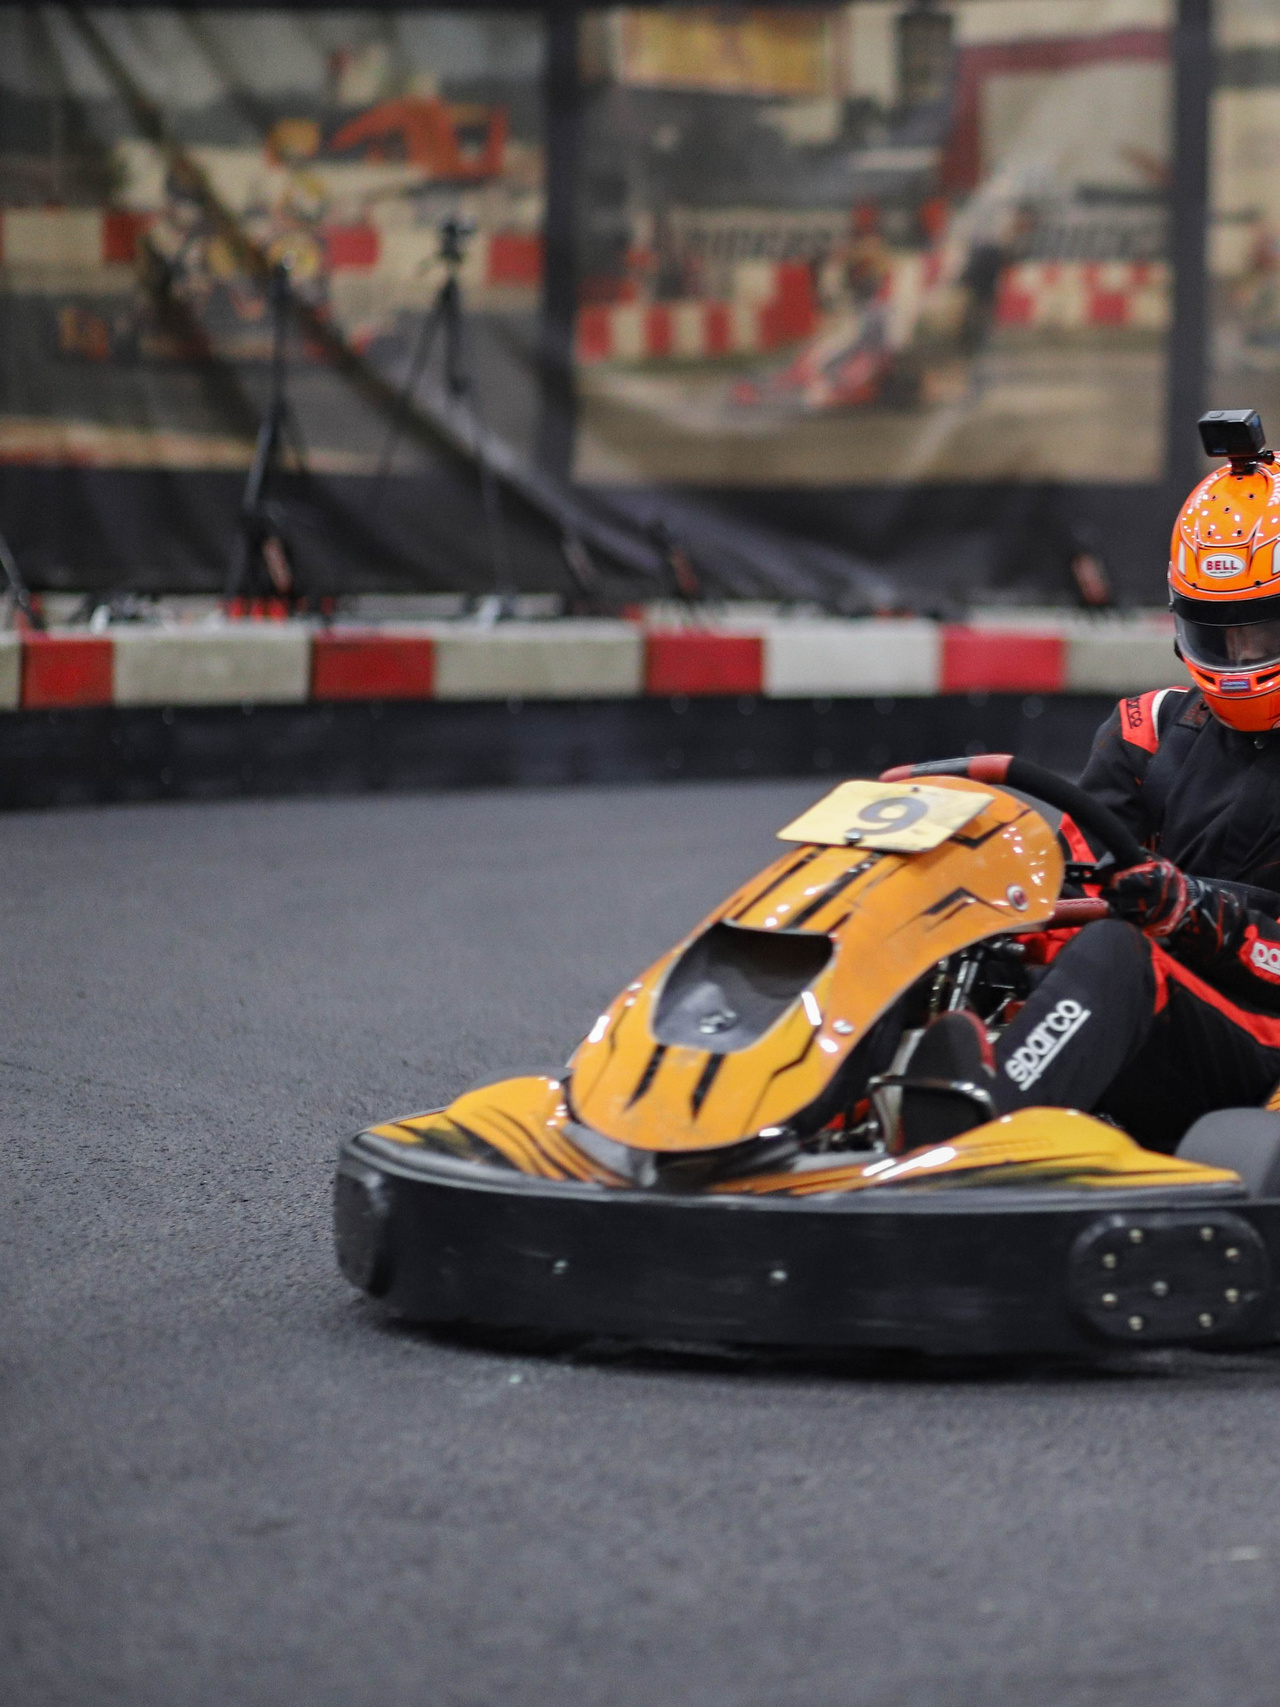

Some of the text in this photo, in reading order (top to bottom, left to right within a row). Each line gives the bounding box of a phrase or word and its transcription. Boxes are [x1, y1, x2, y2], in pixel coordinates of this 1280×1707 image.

[1206, 560, 1240, 571] BELL
[850, 797, 928, 837] 9
[1004, 999, 1085, 1084] sparco
